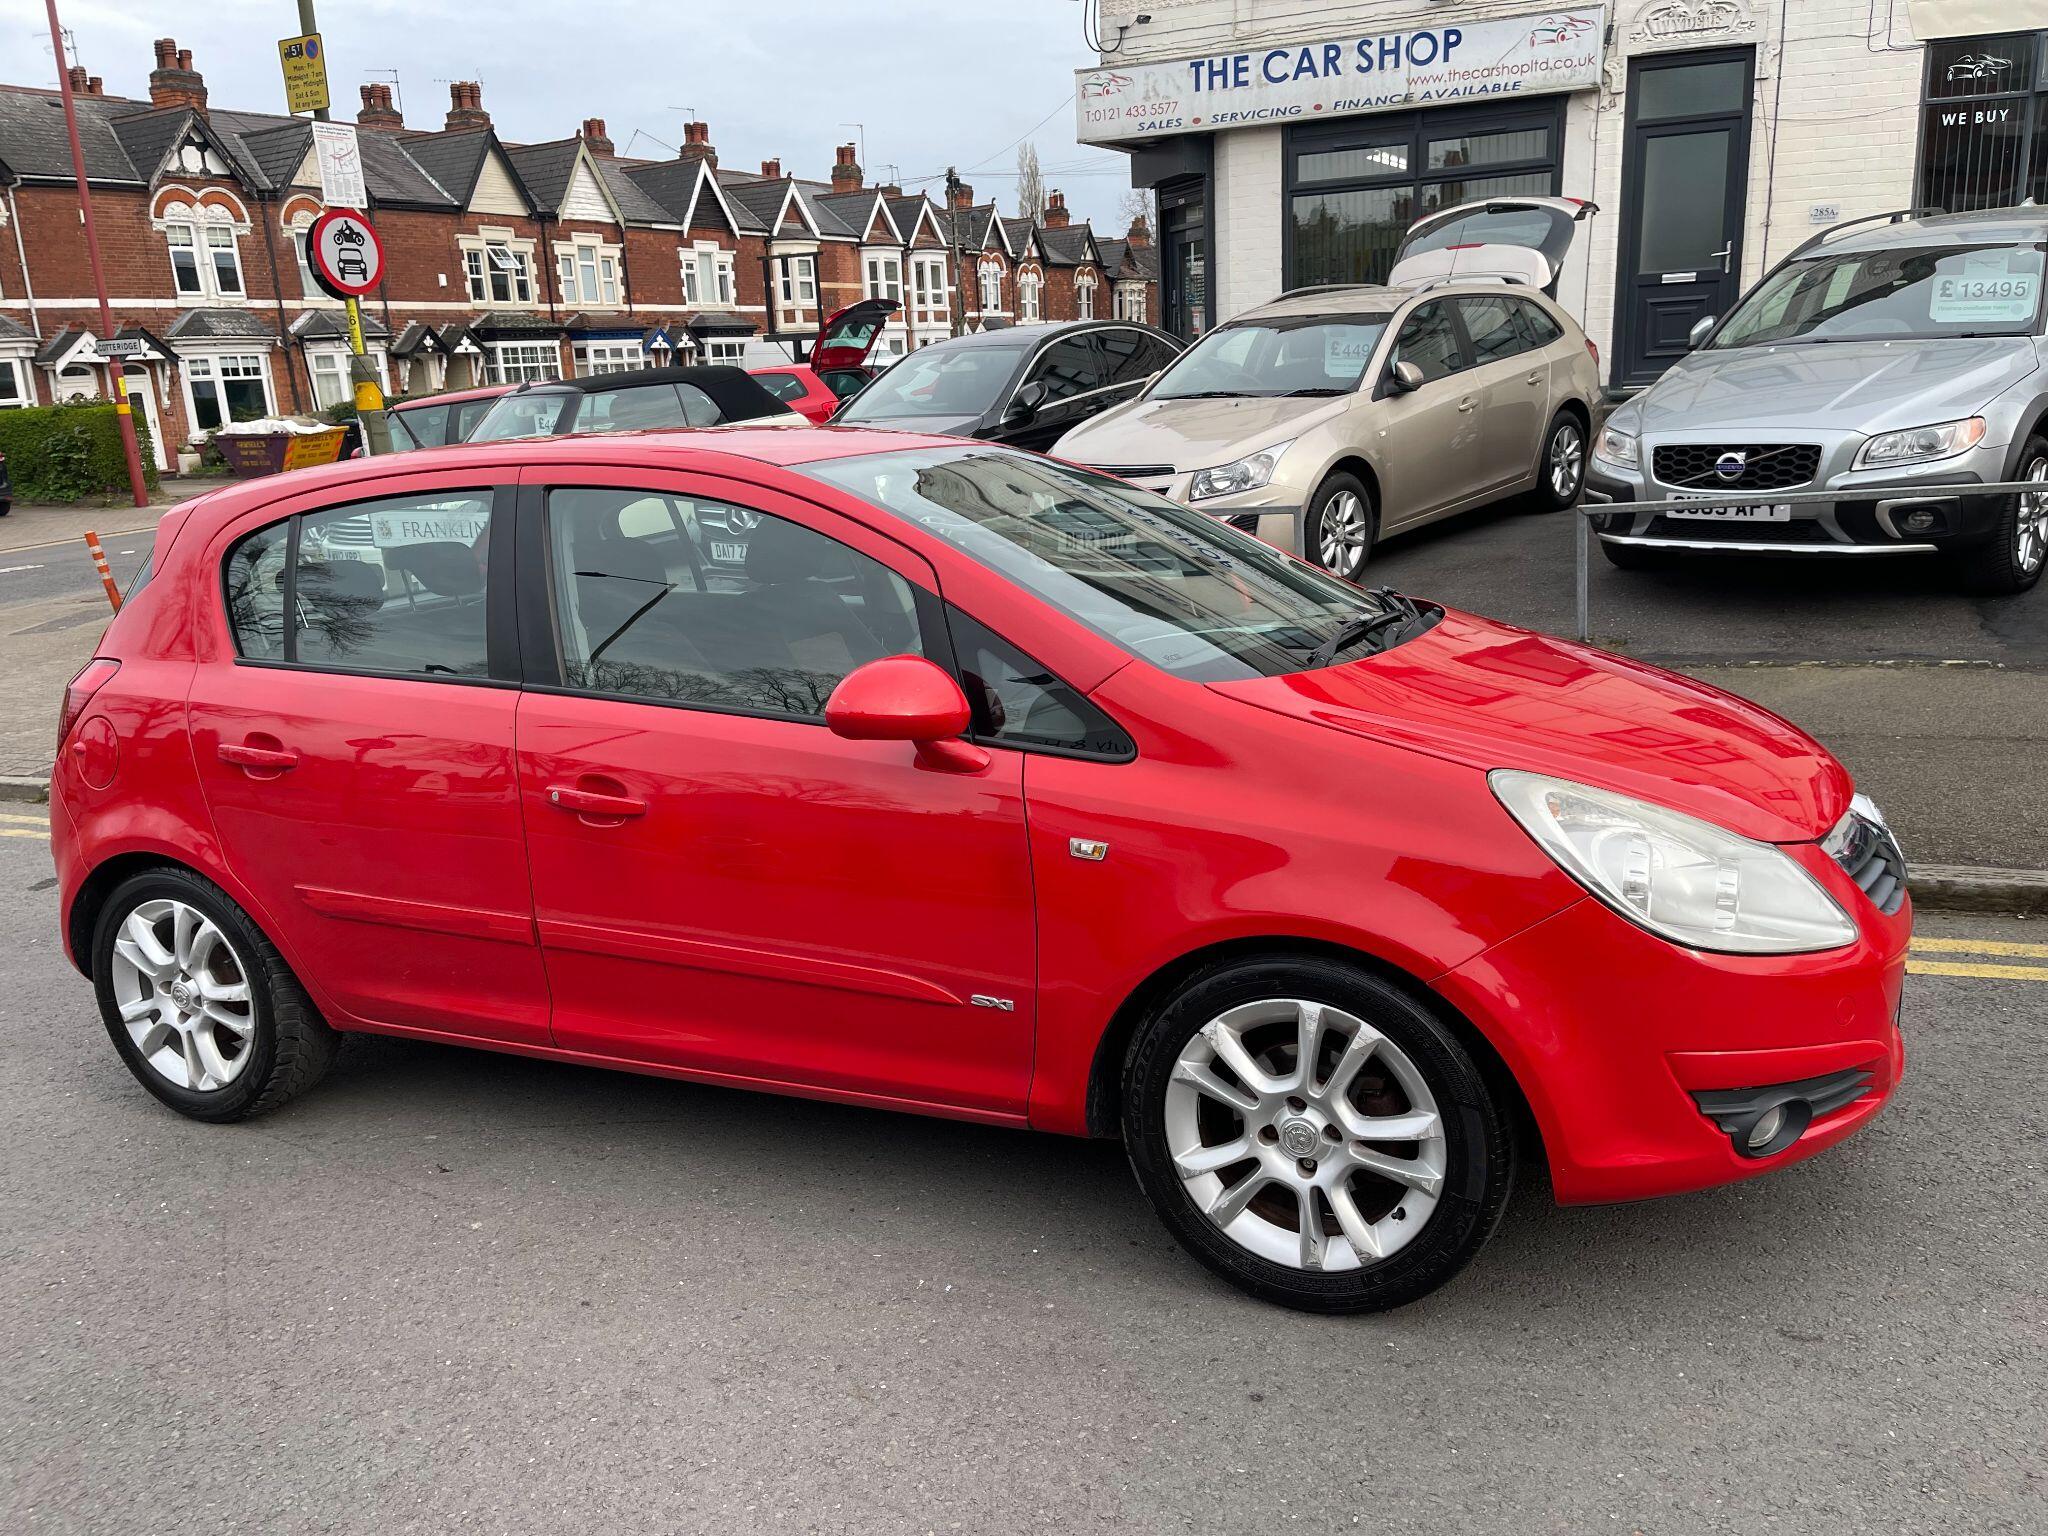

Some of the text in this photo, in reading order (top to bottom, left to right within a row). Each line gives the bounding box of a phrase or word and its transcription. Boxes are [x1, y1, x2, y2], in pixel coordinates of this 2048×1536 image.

[1190, 54, 1249, 92] THE
[1262, 44, 1342, 84] CAR
[1355, 29, 1462, 73] SHOP
[1406, 53, 1596, 87] www.thecarshopltd.co.uk
[1085, 101, 1179, 122] T:0121 433 5577
[1137, 80, 1522, 132] SALES SERVICING FINANCE AVAILABLE
[1942, 108, 2010, 126] WE BUY
[349, 315, 357, 326] 6
[97, 341, 138, 352] COTTERIDGE
